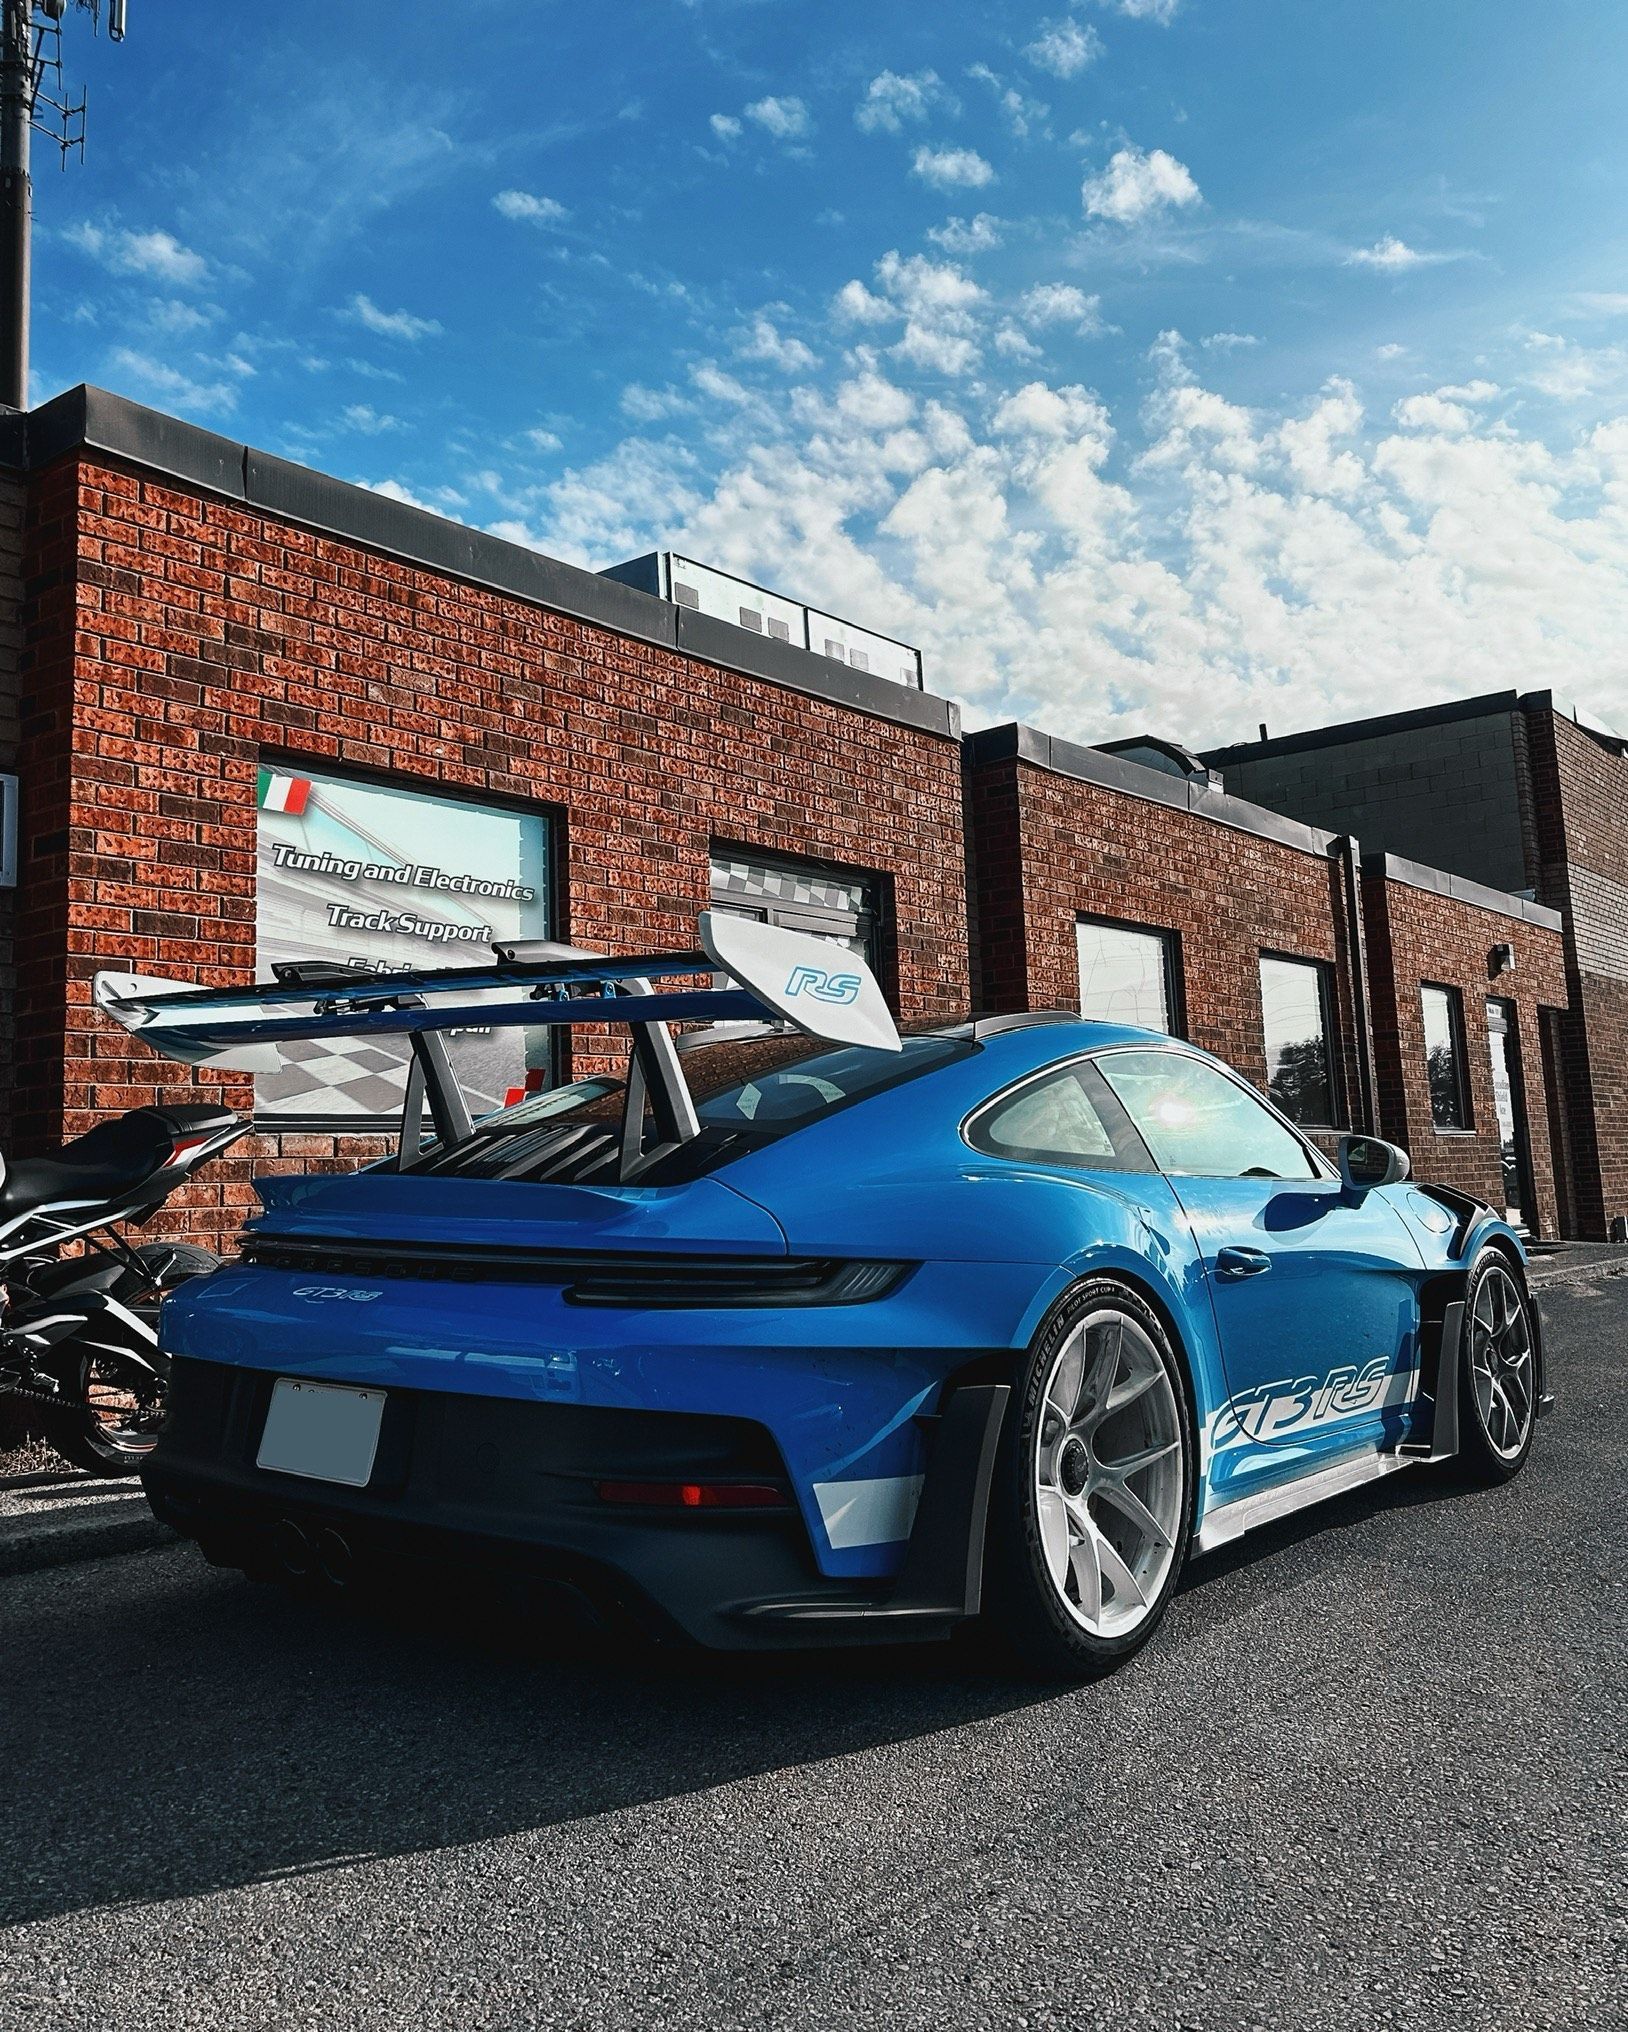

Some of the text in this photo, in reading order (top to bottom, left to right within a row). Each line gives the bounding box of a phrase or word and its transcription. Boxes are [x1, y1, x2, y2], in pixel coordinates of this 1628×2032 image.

[272, 842, 534, 902] Tuning and Electronics
[327, 904, 492, 944] Track Support
[785, 966, 861, 1005] RS
[1028, 1313, 1065, 1407] MICHELIN
